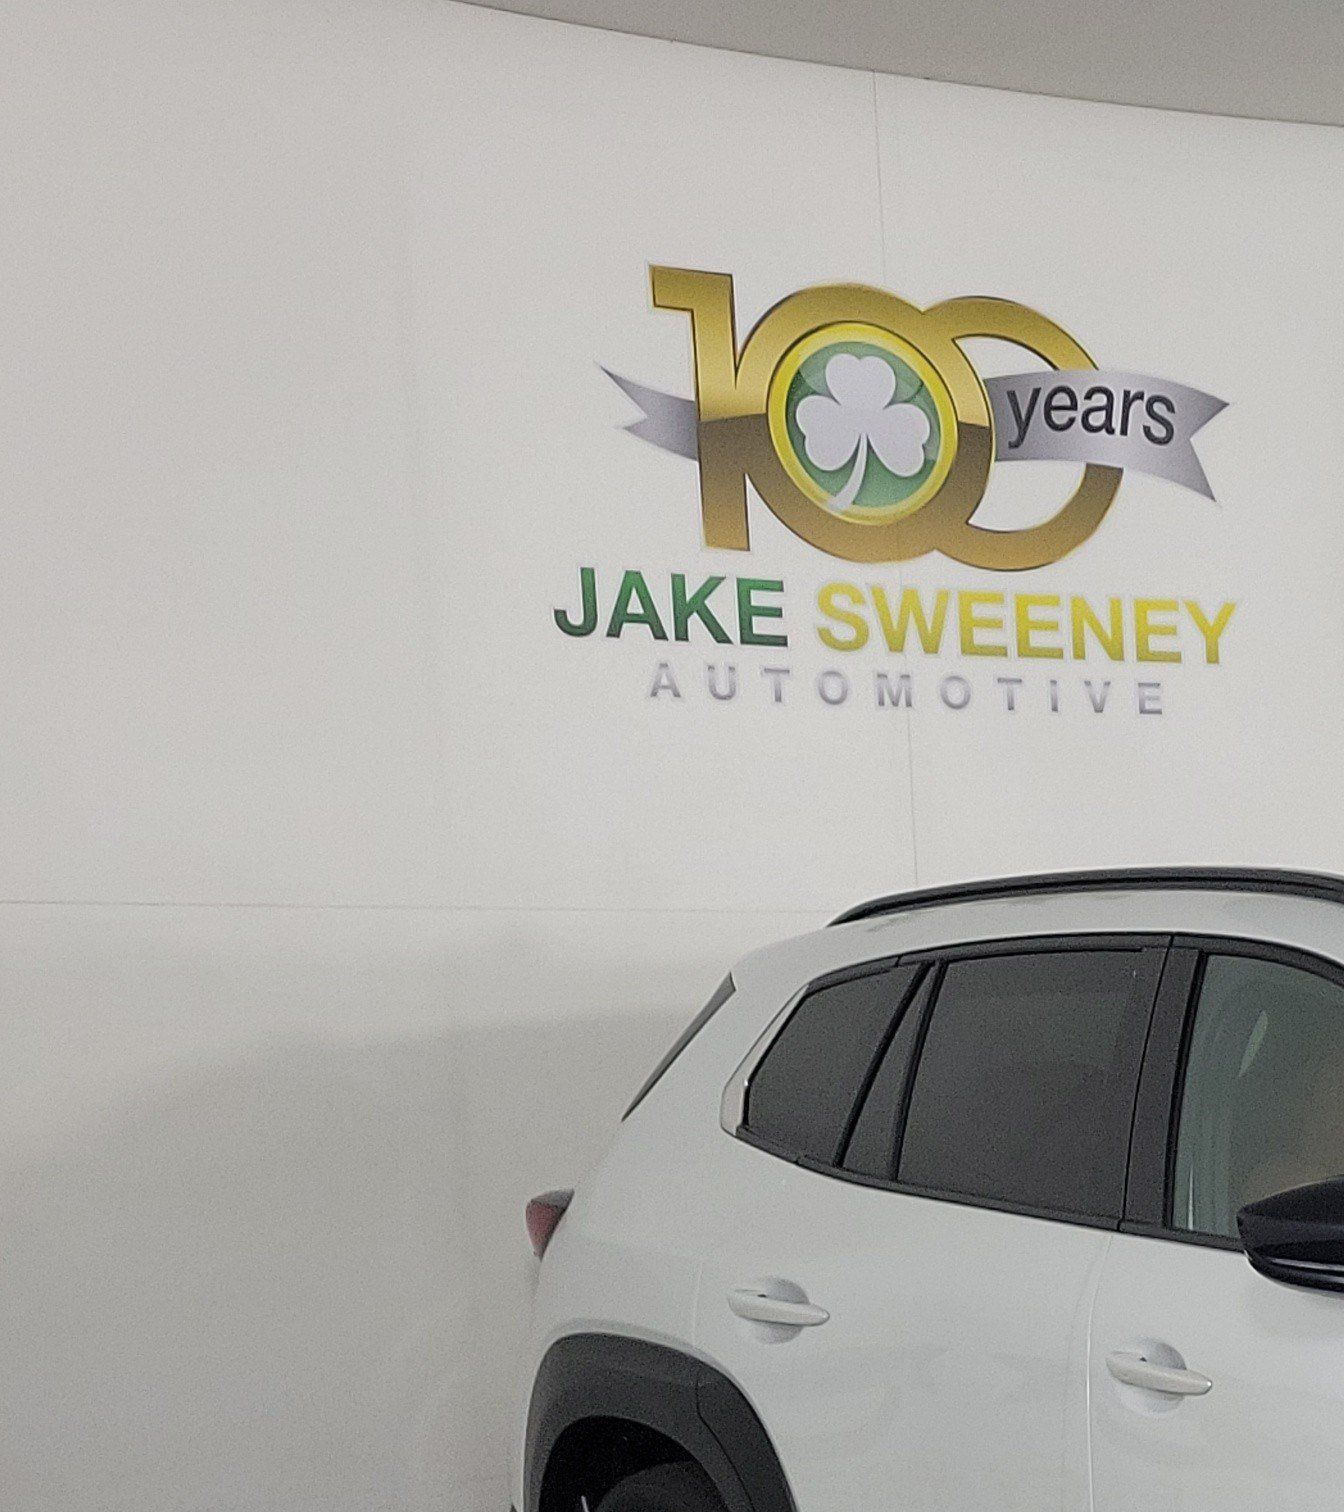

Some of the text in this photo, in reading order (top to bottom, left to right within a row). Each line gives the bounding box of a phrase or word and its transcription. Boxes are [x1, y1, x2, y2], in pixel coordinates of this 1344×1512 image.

[648, 263, 1176, 573] 100 years
[553, 567, 1237, 665] JAKE SWEENEY
[649, 661, 1164, 716] AUTOMOTIVE
